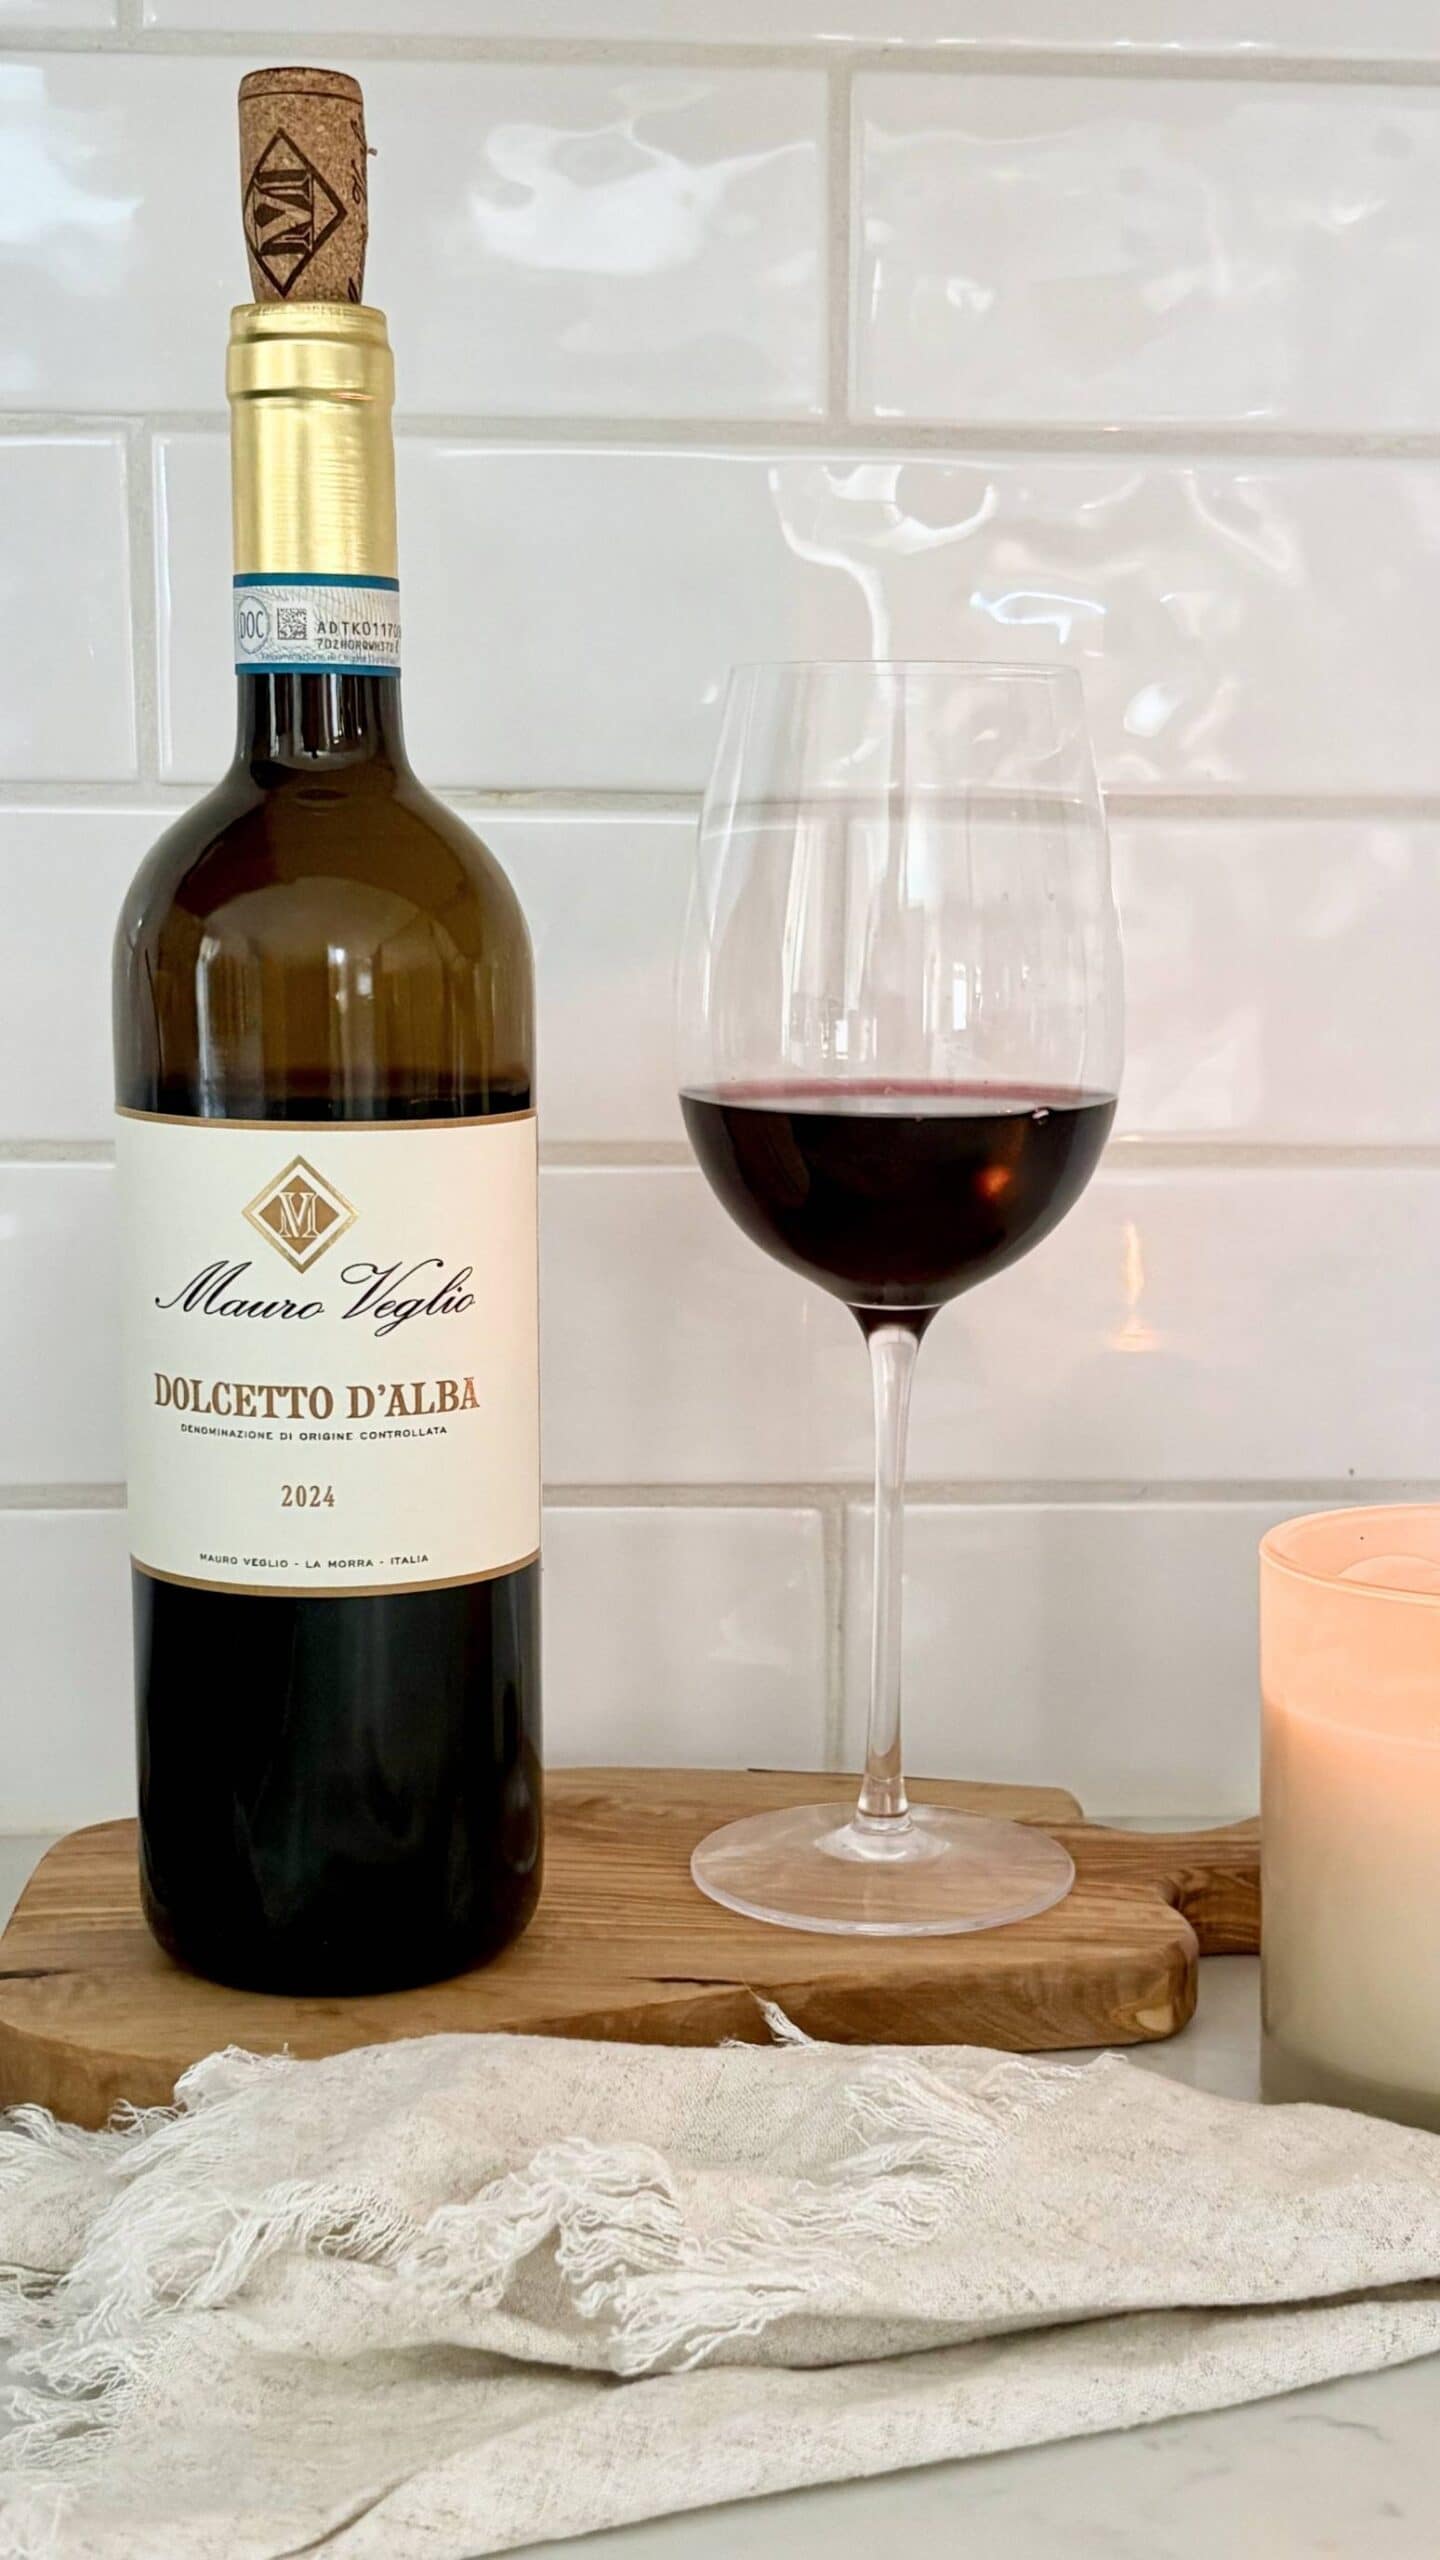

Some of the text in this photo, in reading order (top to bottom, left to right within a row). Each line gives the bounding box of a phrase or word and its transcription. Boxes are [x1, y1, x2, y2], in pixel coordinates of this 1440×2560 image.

[239, 611, 265, 639] DOC
[278, 1191, 321, 1238] M
[154, 1257, 476, 1338] Mauro Veglio
[153, 1372, 481, 1420] DOLCETTO D’ALBA
[180, 1423, 448, 1441] DENOMINAZIONE DI ORIGINE CONTROLLATA
[281, 1484, 336, 1508] 2024
[199, 1553, 238, 1565] MAURO
[243, 1557, 289, 1568] VEGLIO
[305, 1560, 321, 1569] LA
[328, 1559, 374, 1568] MORRA
[390, 1554, 429, 1565] ITALIA
